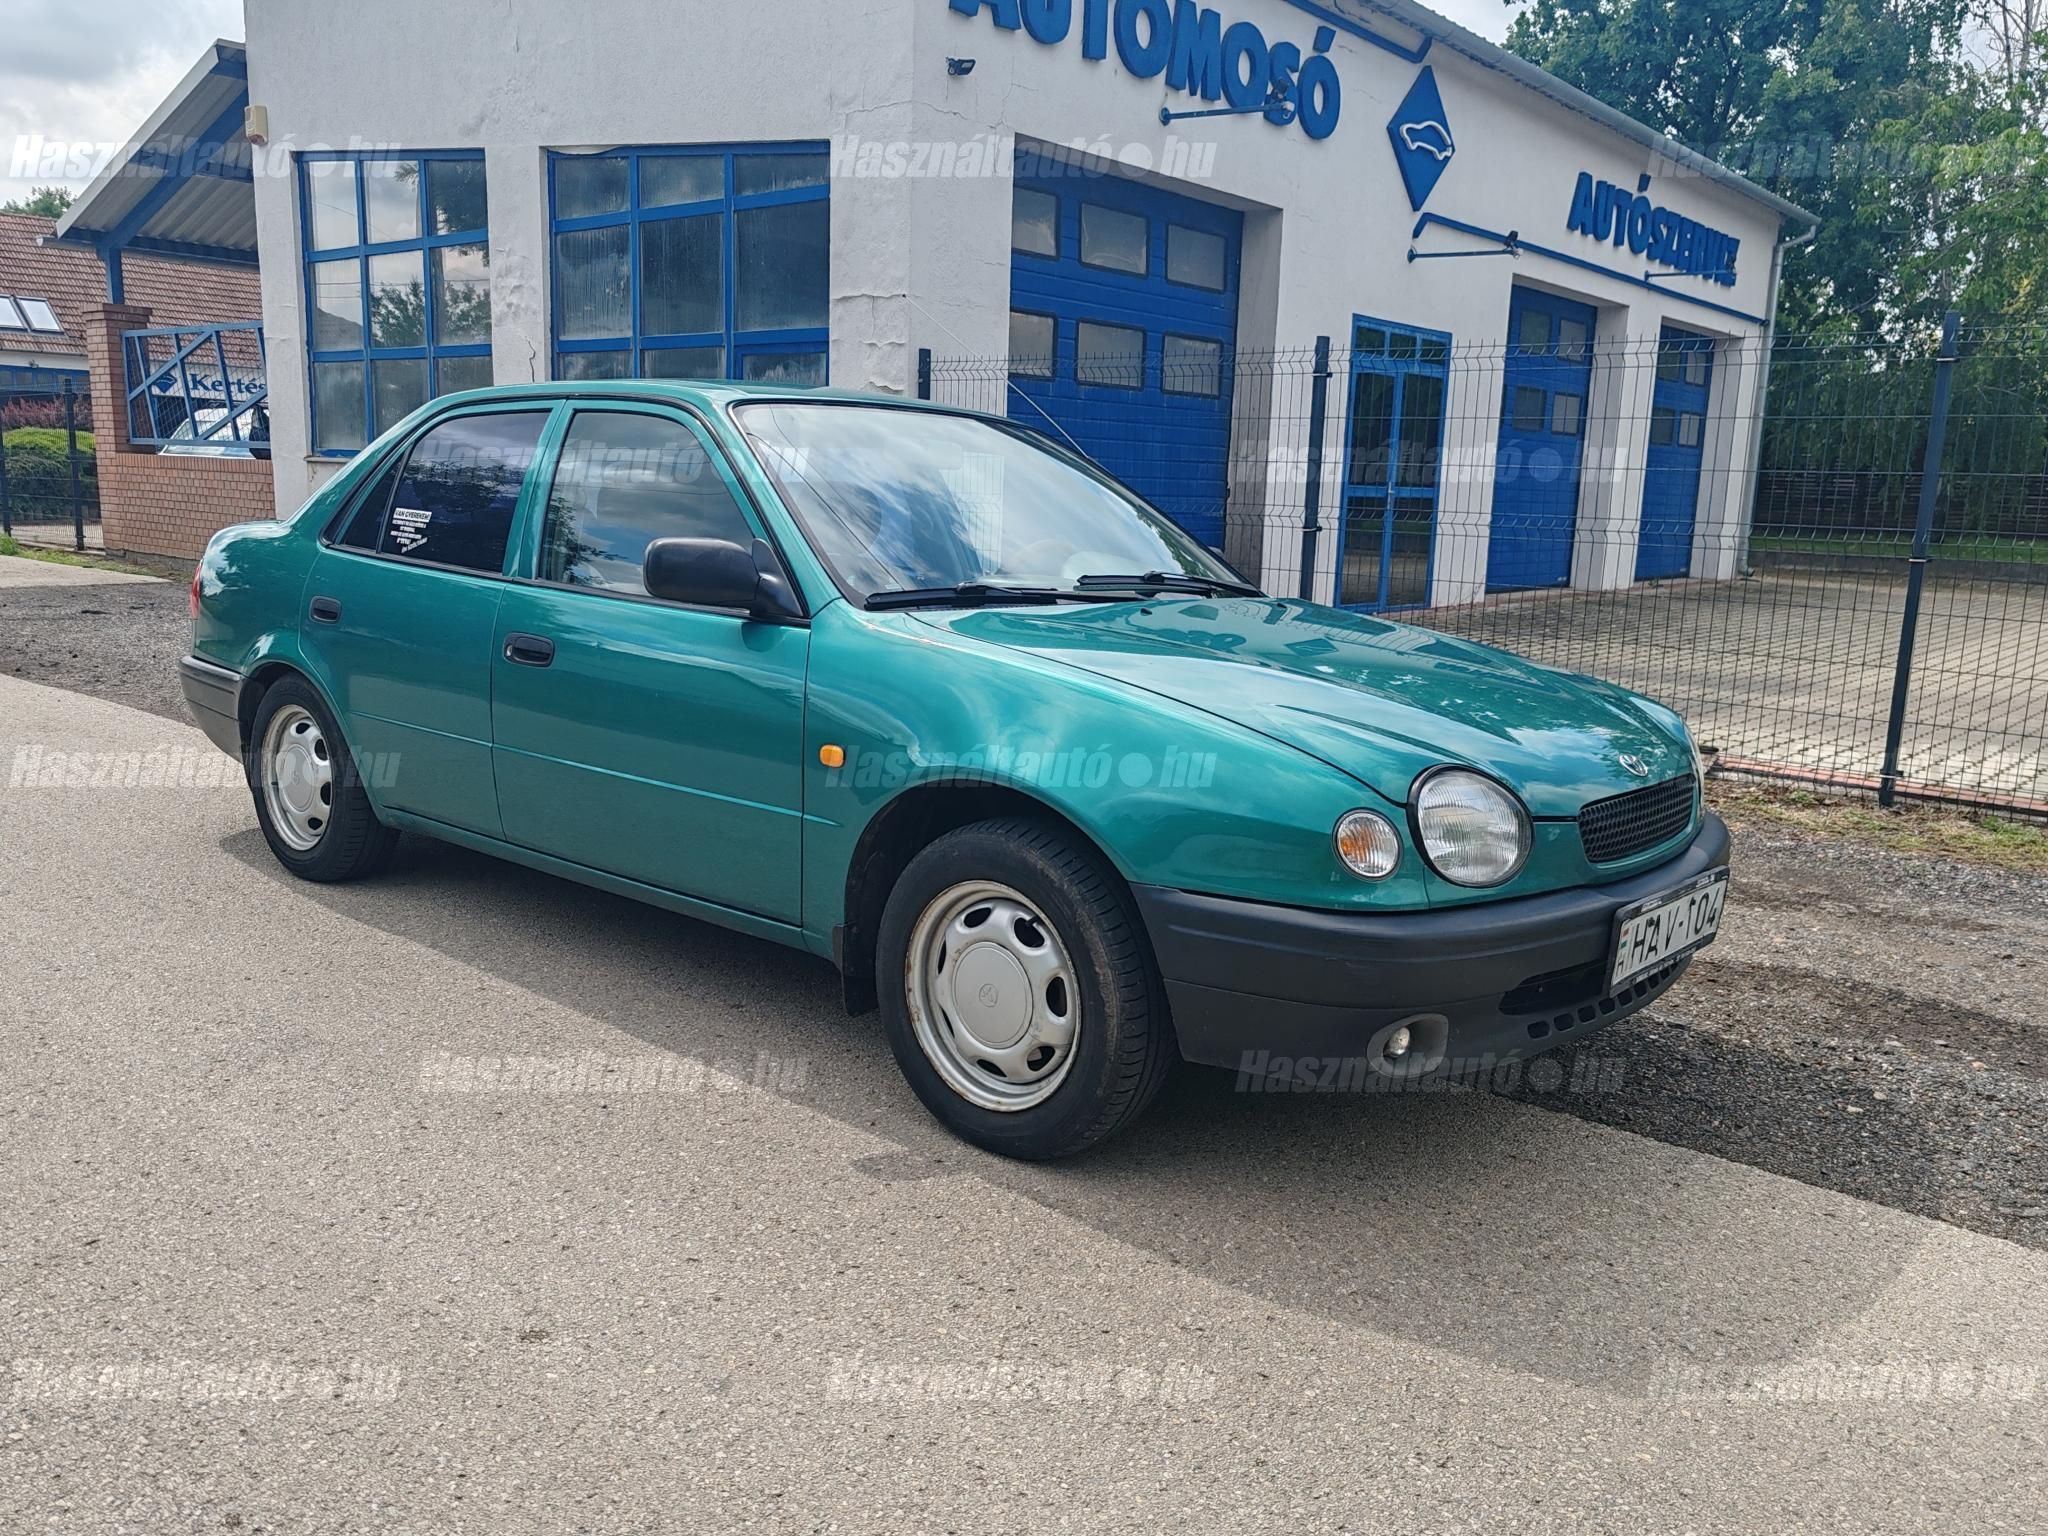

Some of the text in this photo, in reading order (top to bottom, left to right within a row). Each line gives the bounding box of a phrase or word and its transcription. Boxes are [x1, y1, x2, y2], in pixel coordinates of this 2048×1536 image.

[949, 0, 1341, 140] UTOMOSÓ
[1566, 171, 1740, 288] AUTÓSZERVIZ
[189, 374, 266, 394] Ketés
[1630, 887, 1721, 964] HAV-104
